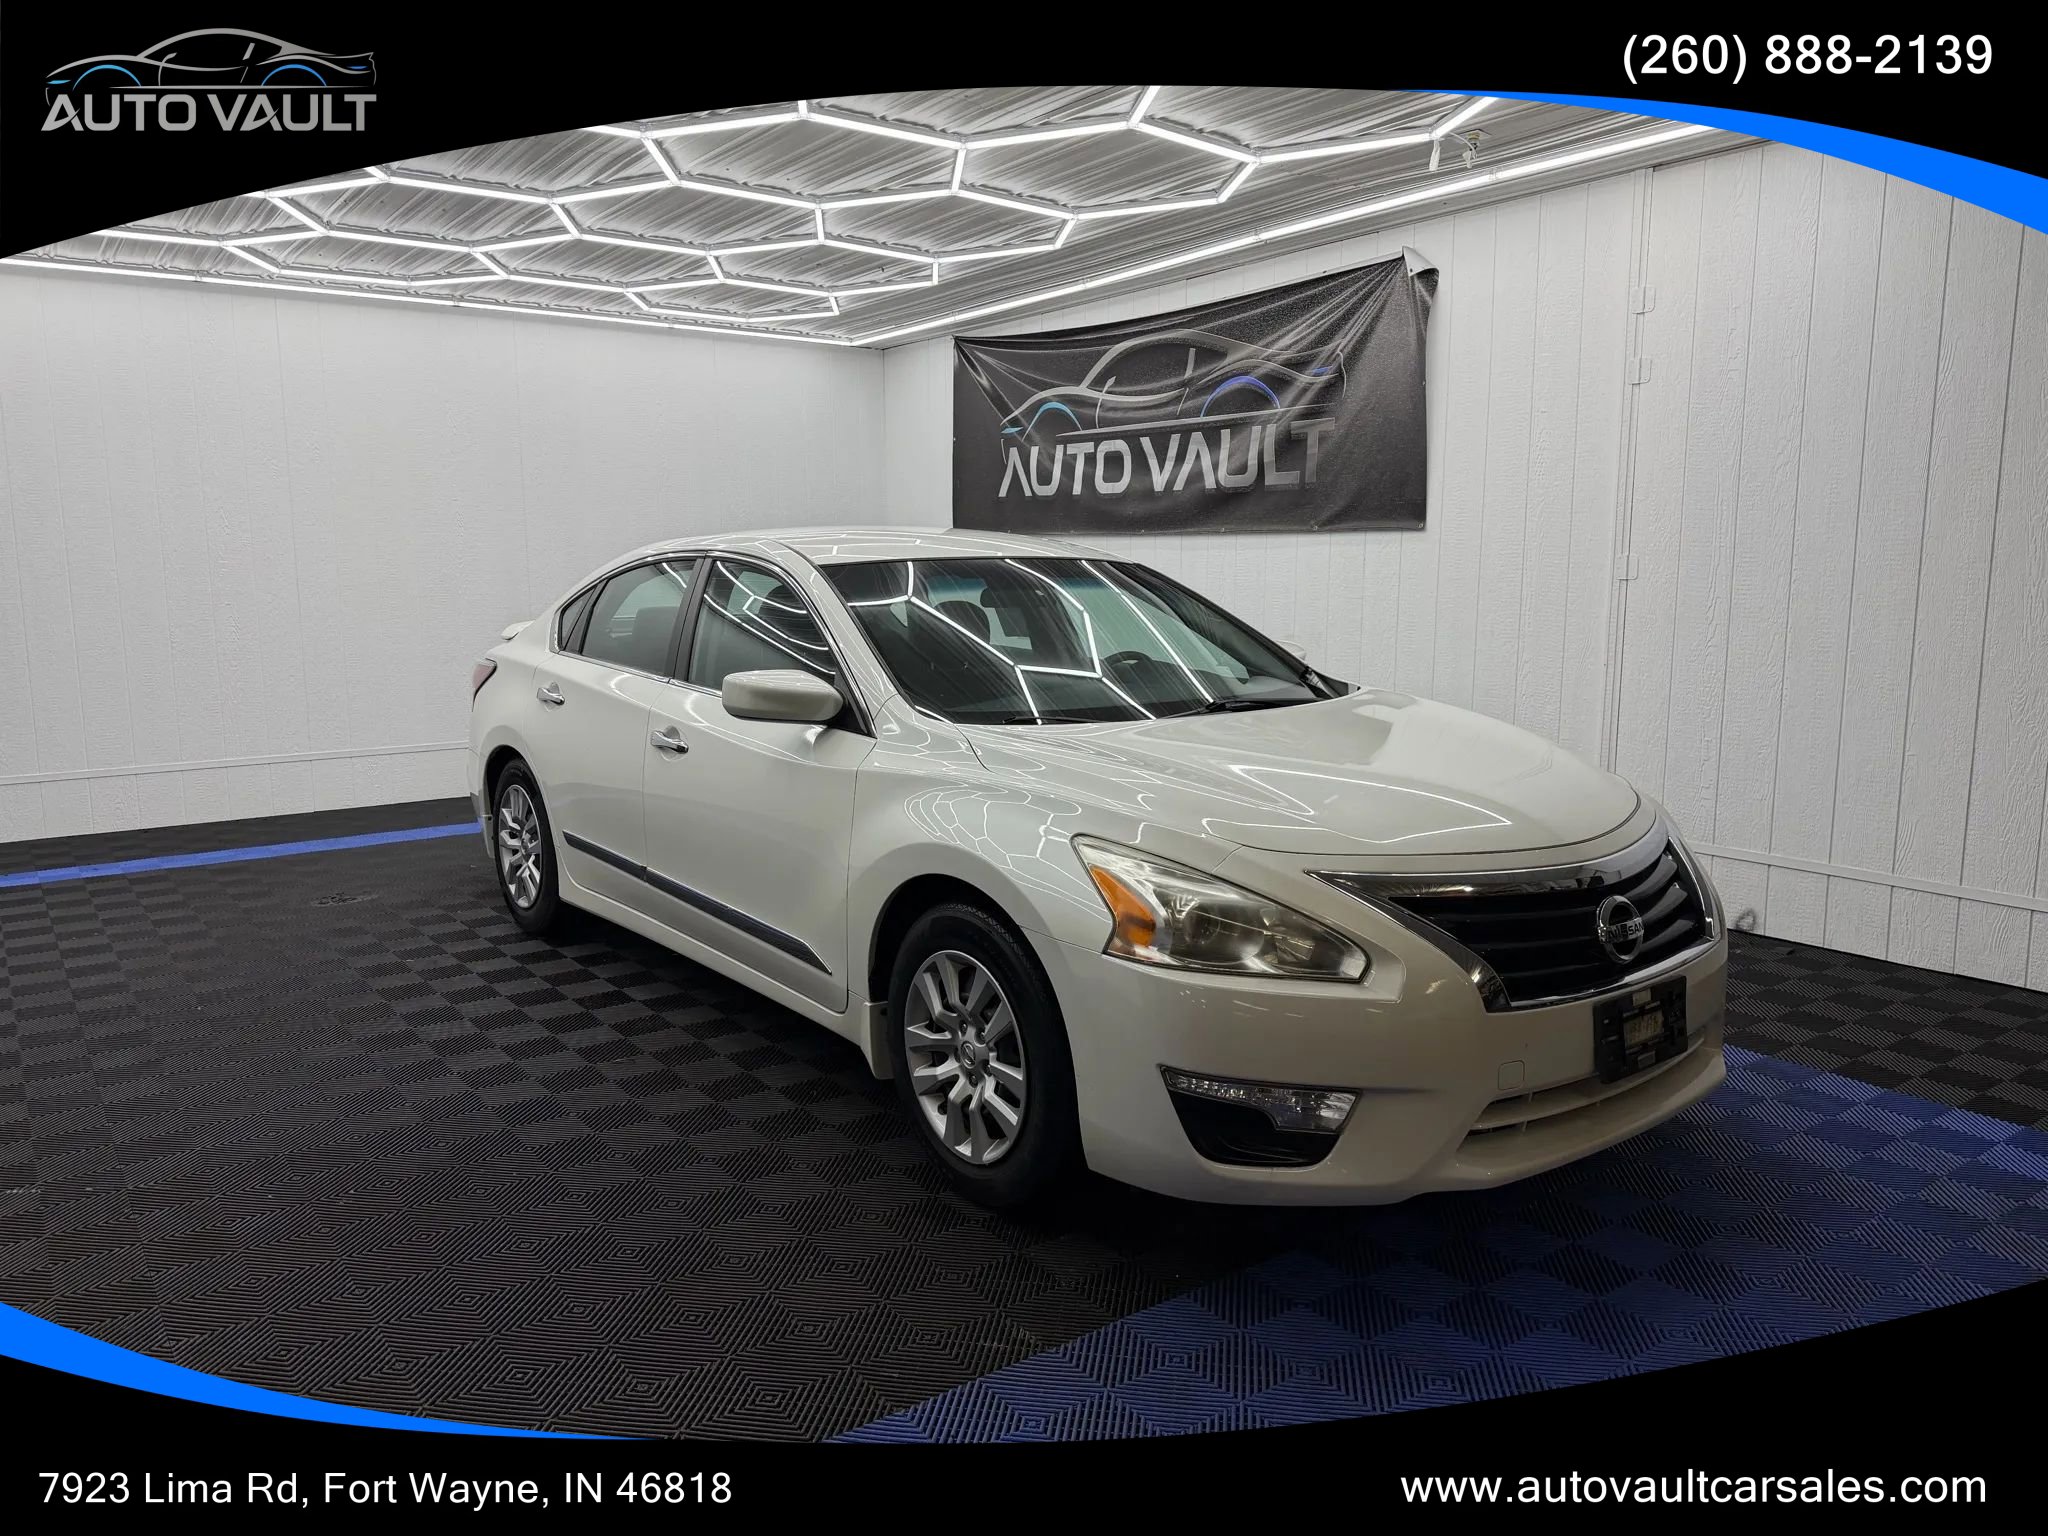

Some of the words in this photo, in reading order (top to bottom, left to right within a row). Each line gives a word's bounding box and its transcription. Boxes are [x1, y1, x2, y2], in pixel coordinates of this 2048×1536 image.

[998, 438, 1132, 498] AUTO
[1139, 417, 1336, 492] VAULT
[1606, 921, 1643, 941] NISSAN
